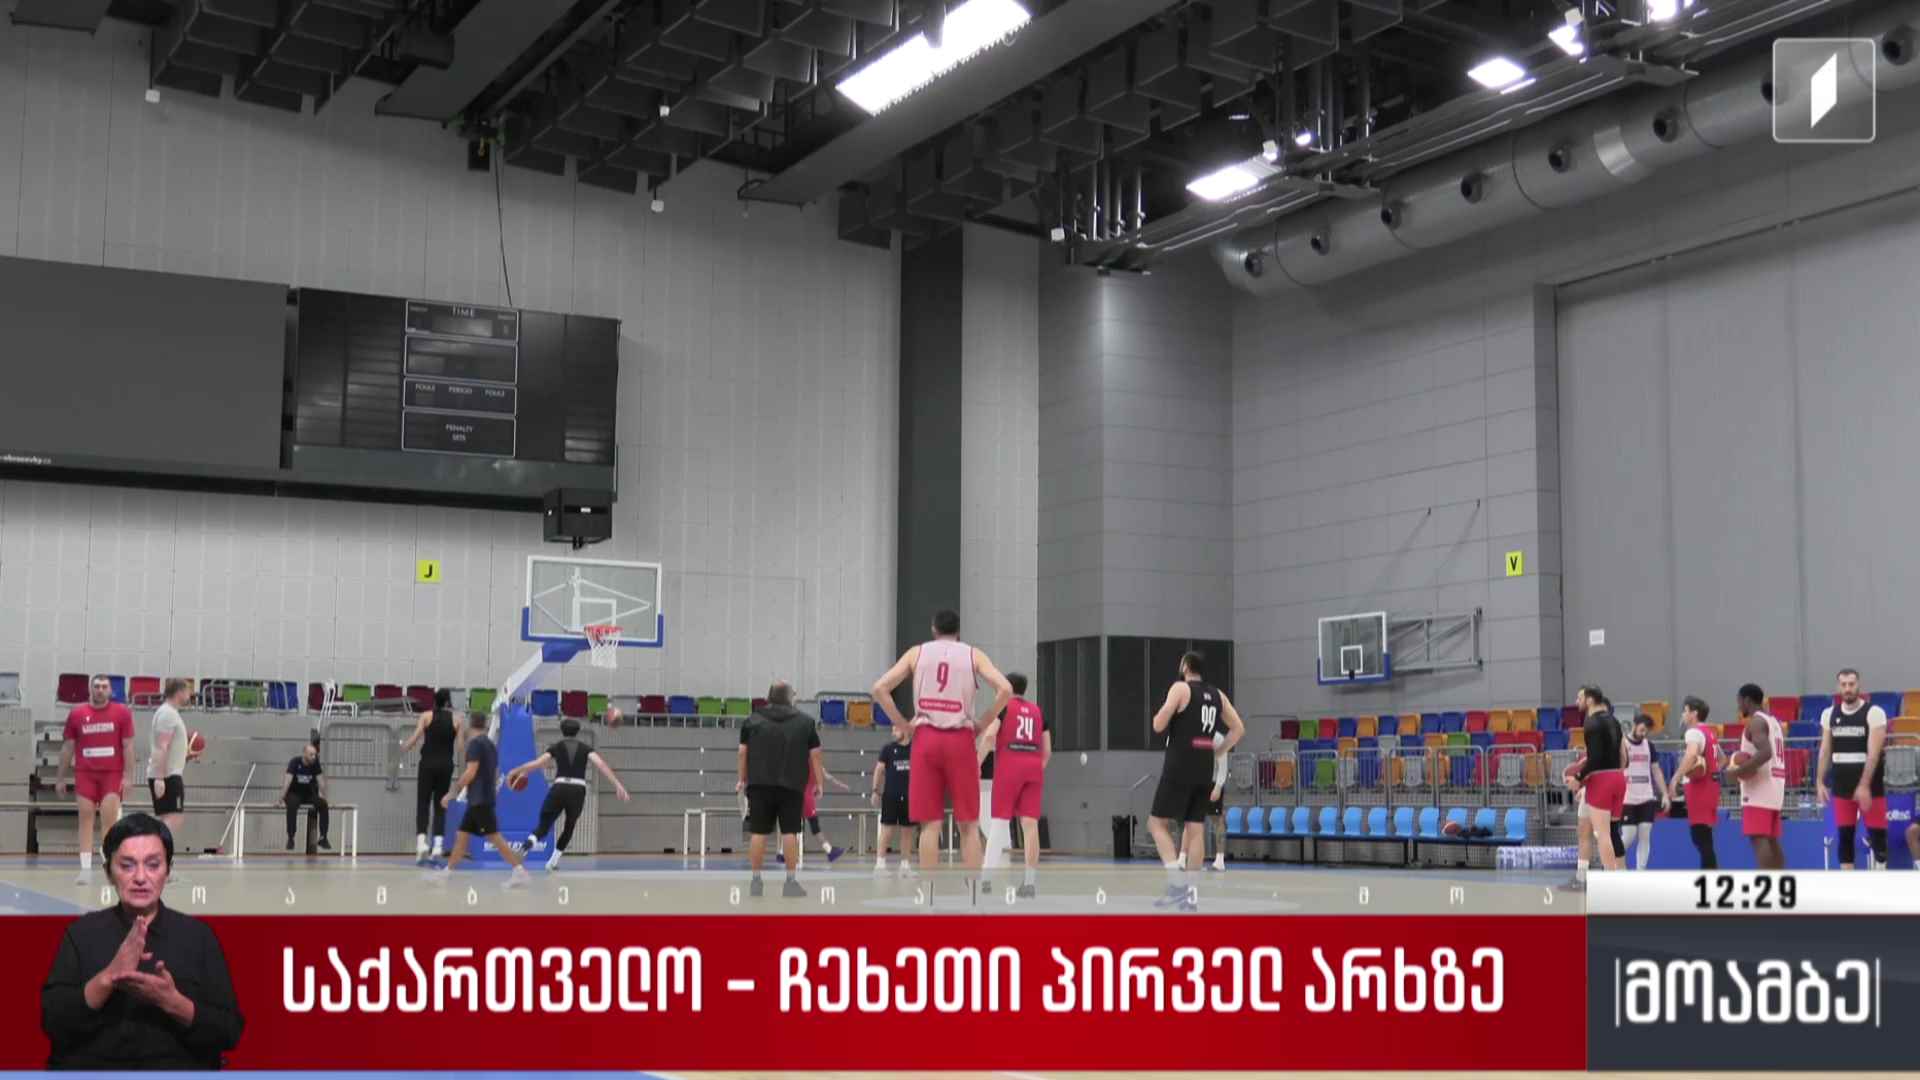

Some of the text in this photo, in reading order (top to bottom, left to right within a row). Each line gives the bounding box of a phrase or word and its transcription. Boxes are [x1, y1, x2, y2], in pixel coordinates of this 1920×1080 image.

[423, 563, 433, 579] J
[1509, 555, 1519, 572] V
[936, 661, 949, 693] 9
[1015, 714, 1034, 741] 24
[1201, 704, 1217, 734] 99
